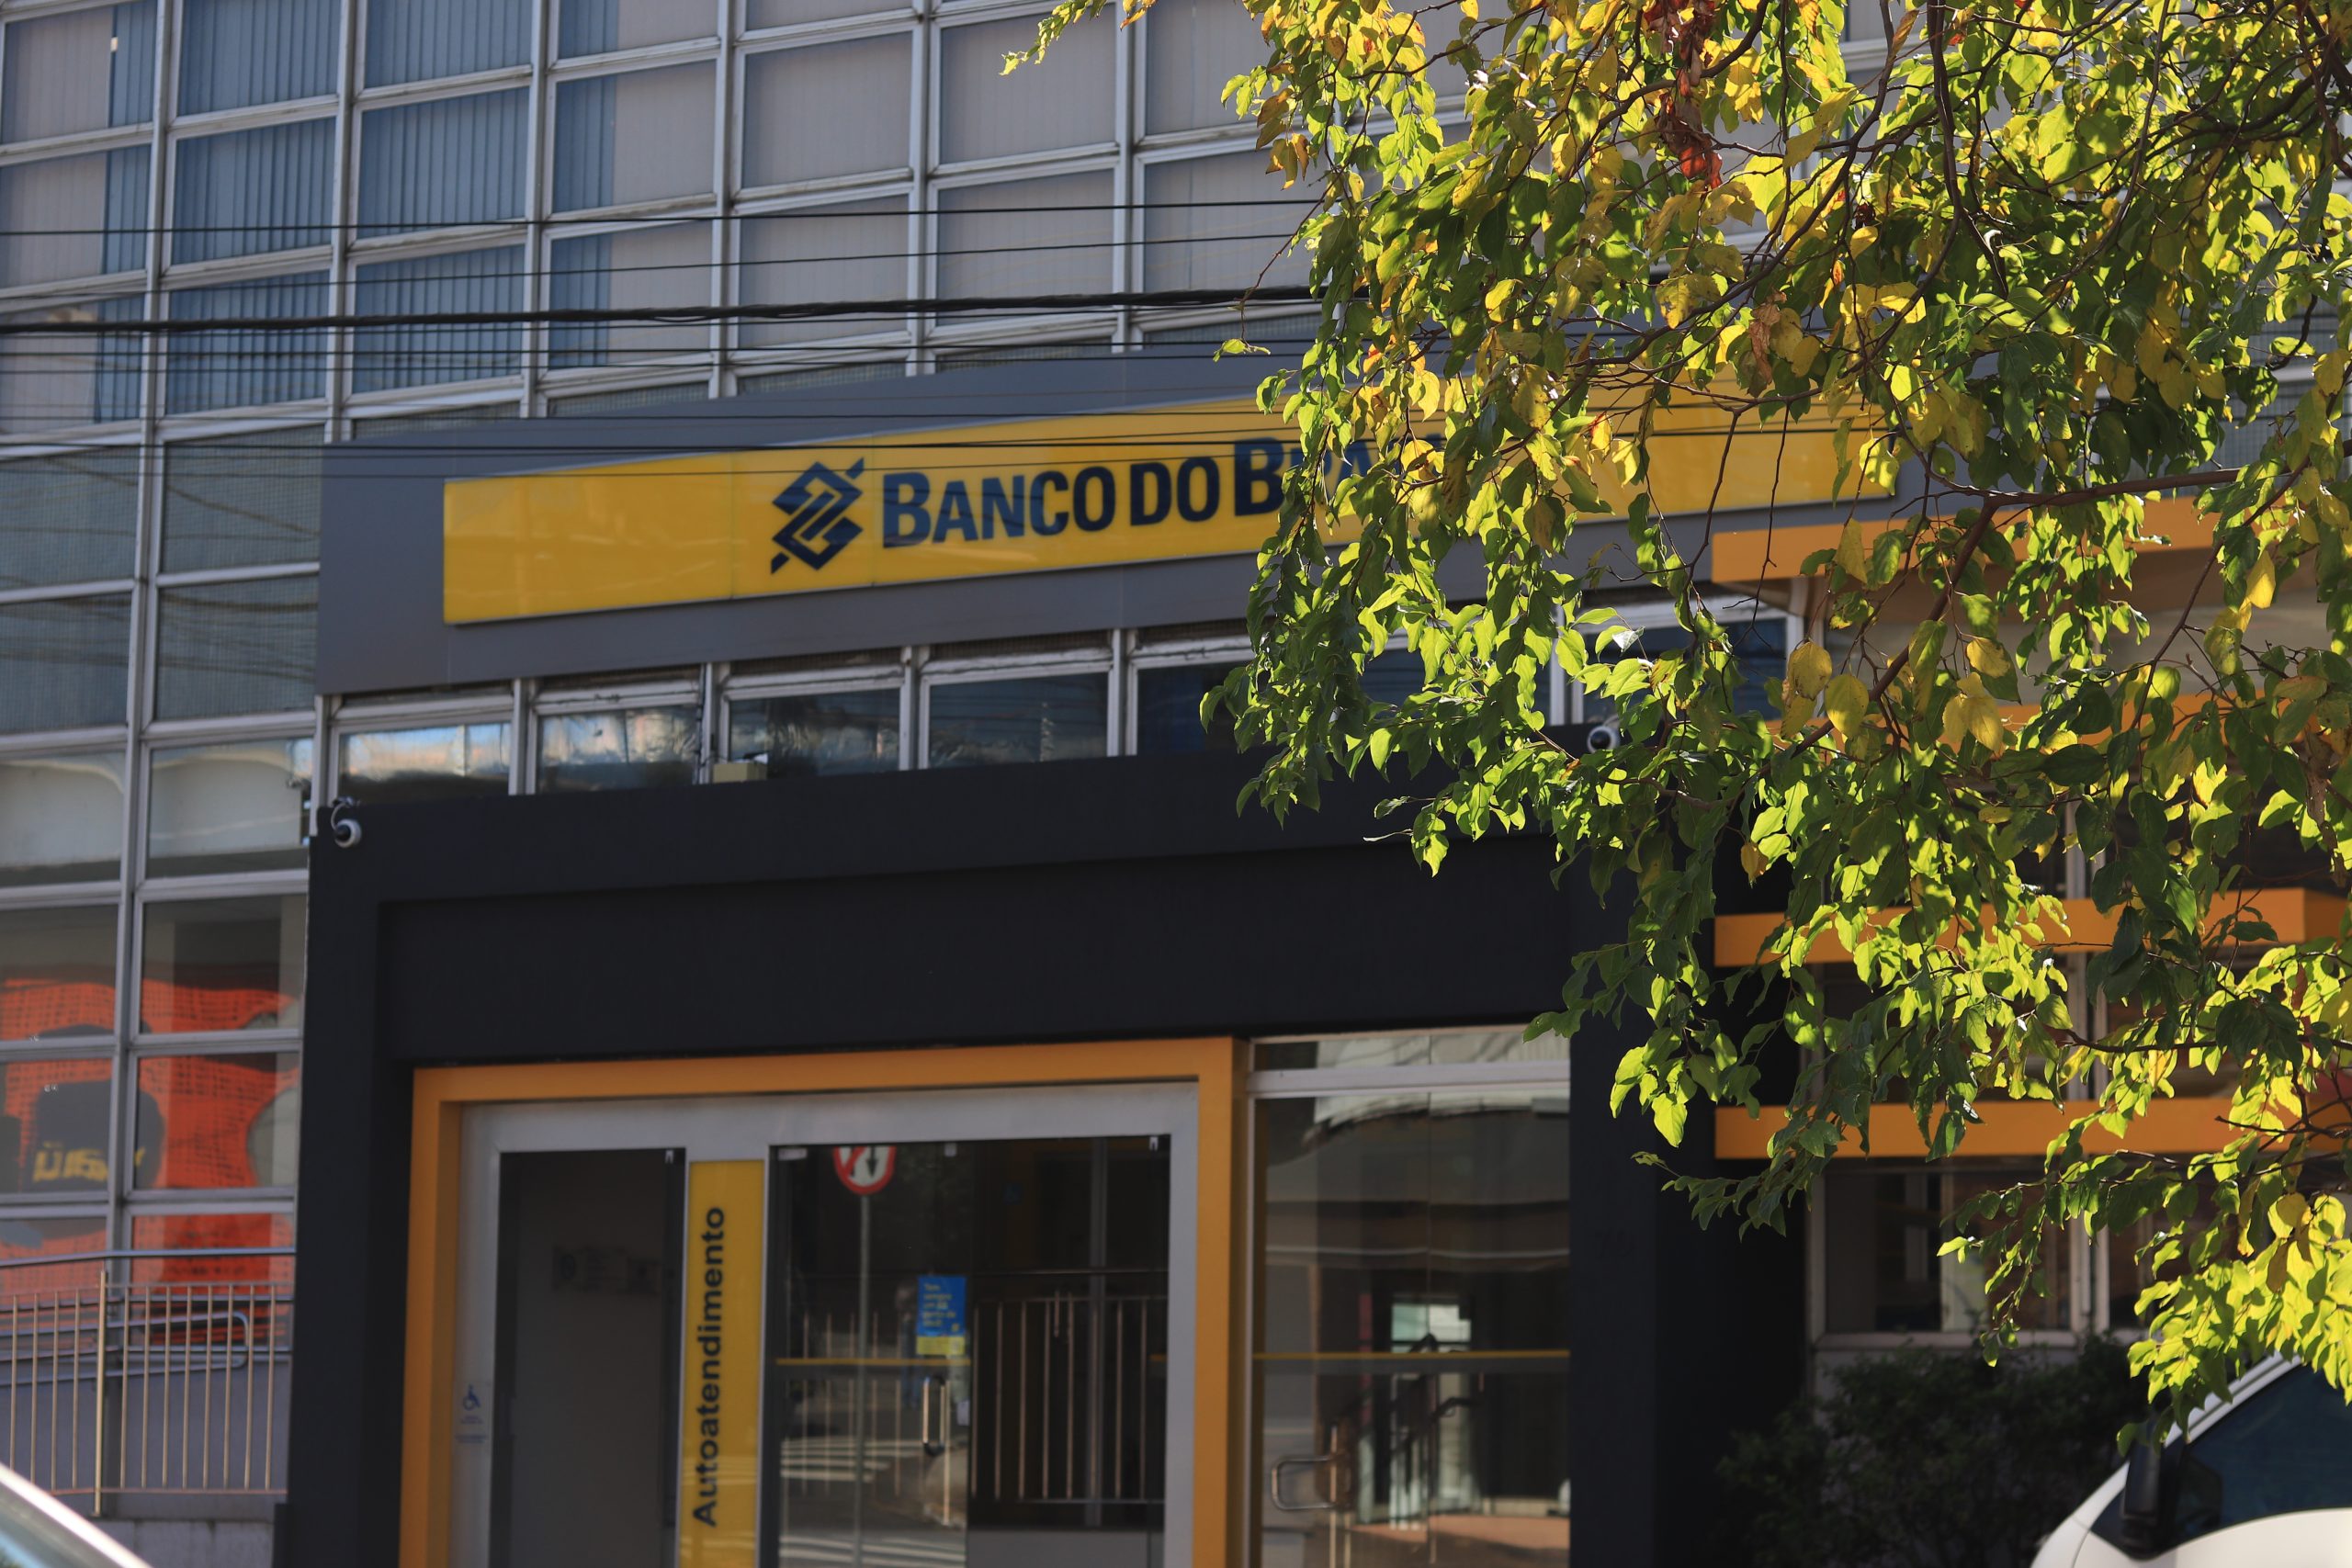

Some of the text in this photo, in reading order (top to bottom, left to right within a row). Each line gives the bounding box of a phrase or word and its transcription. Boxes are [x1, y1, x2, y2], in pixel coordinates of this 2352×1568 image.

[882, 465, 1117, 548] BANCO
[1129, 456, 1220, 526] DO
[693, 1206, 725, 1527] Autoatendimento
